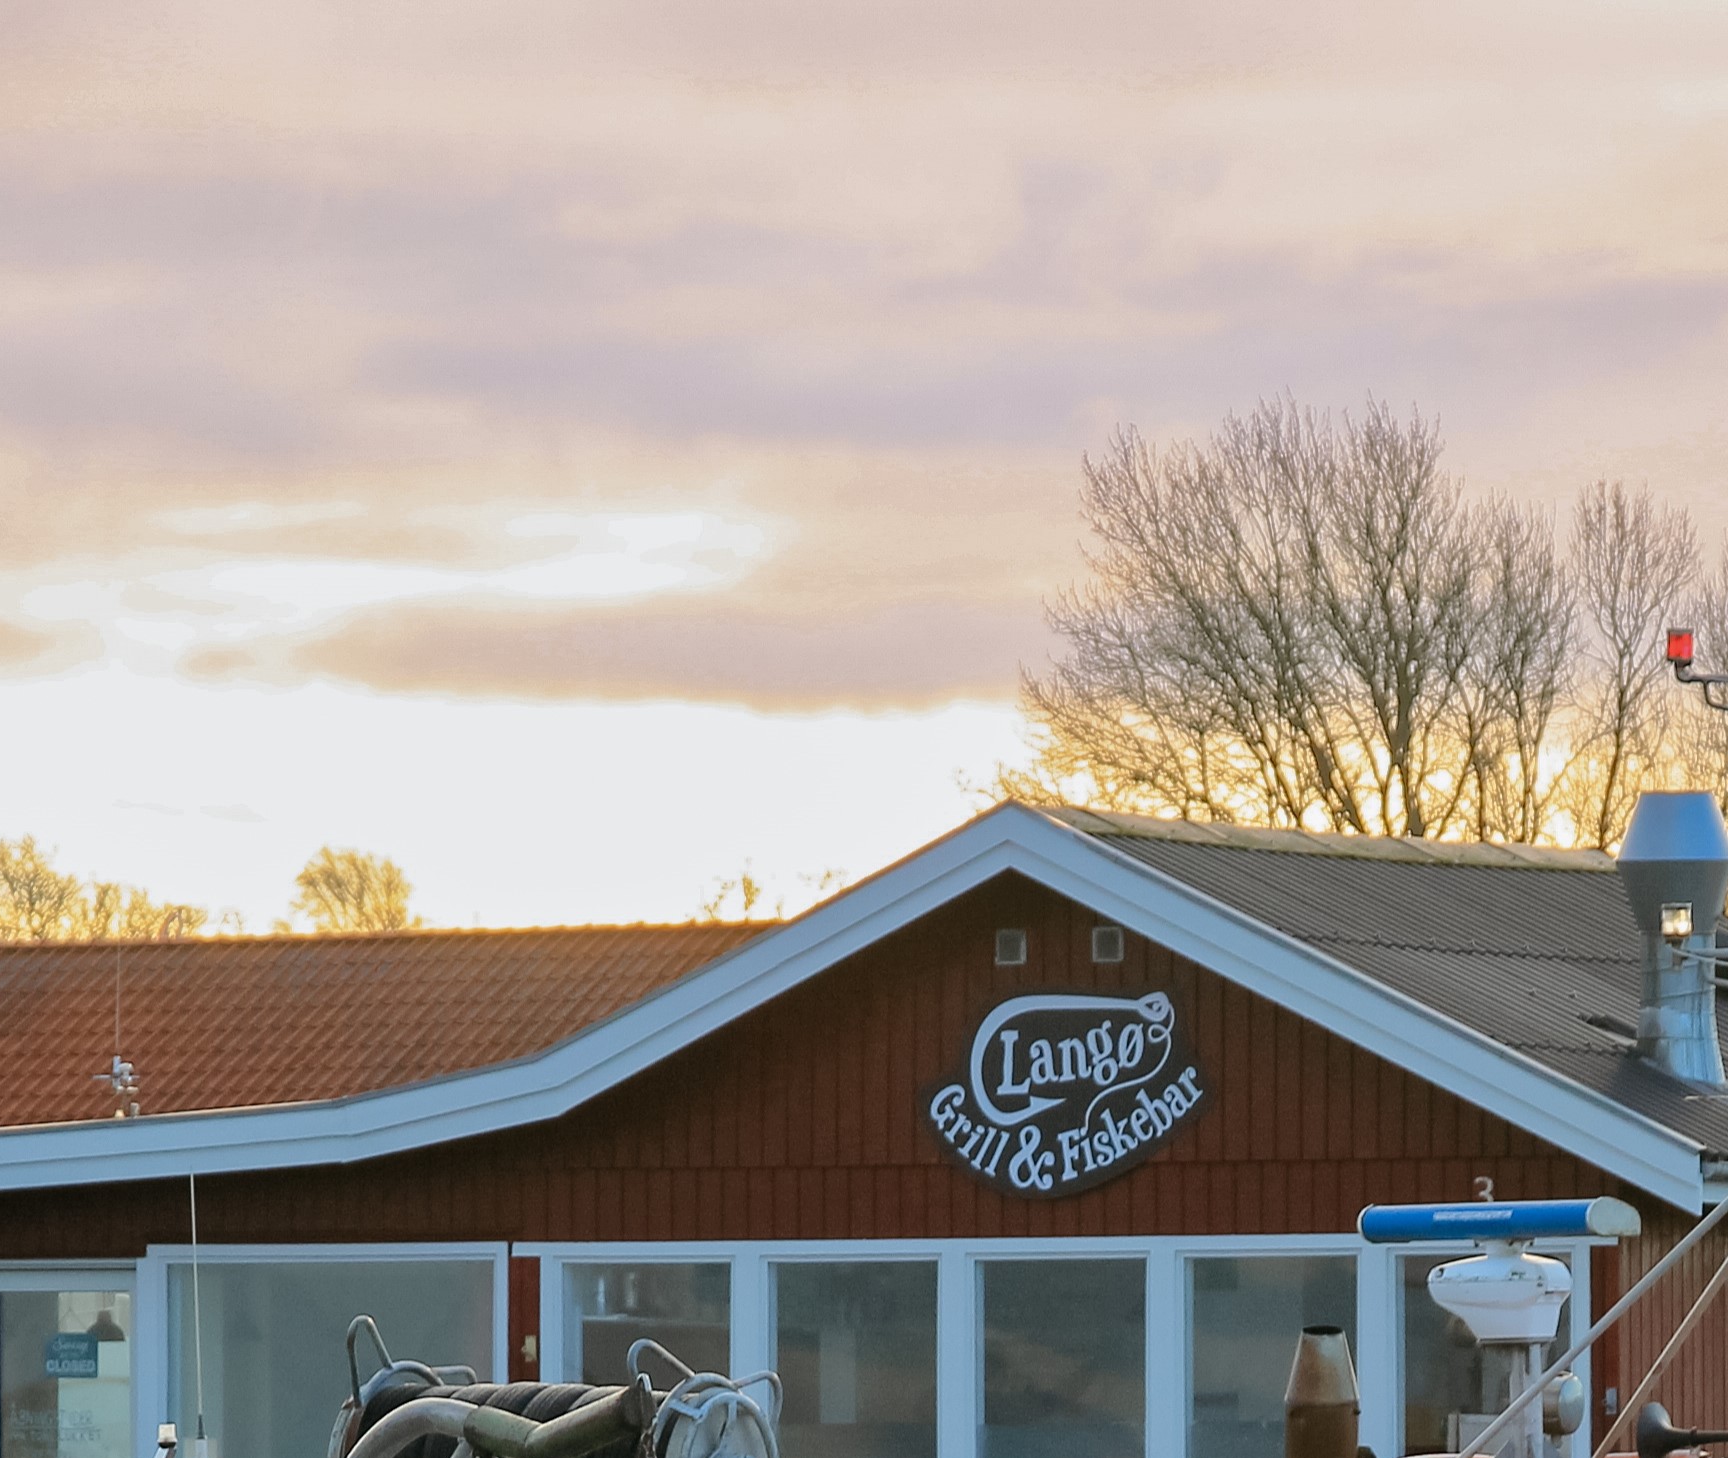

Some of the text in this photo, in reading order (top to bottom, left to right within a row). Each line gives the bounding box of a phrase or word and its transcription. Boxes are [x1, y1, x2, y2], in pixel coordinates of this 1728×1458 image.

[996, 1020, 1145, 1086] Langø
[929, 1066, 1204, 1191] Grill & Fiskebar
[46, 1359, 97, 1373] CLOSED
